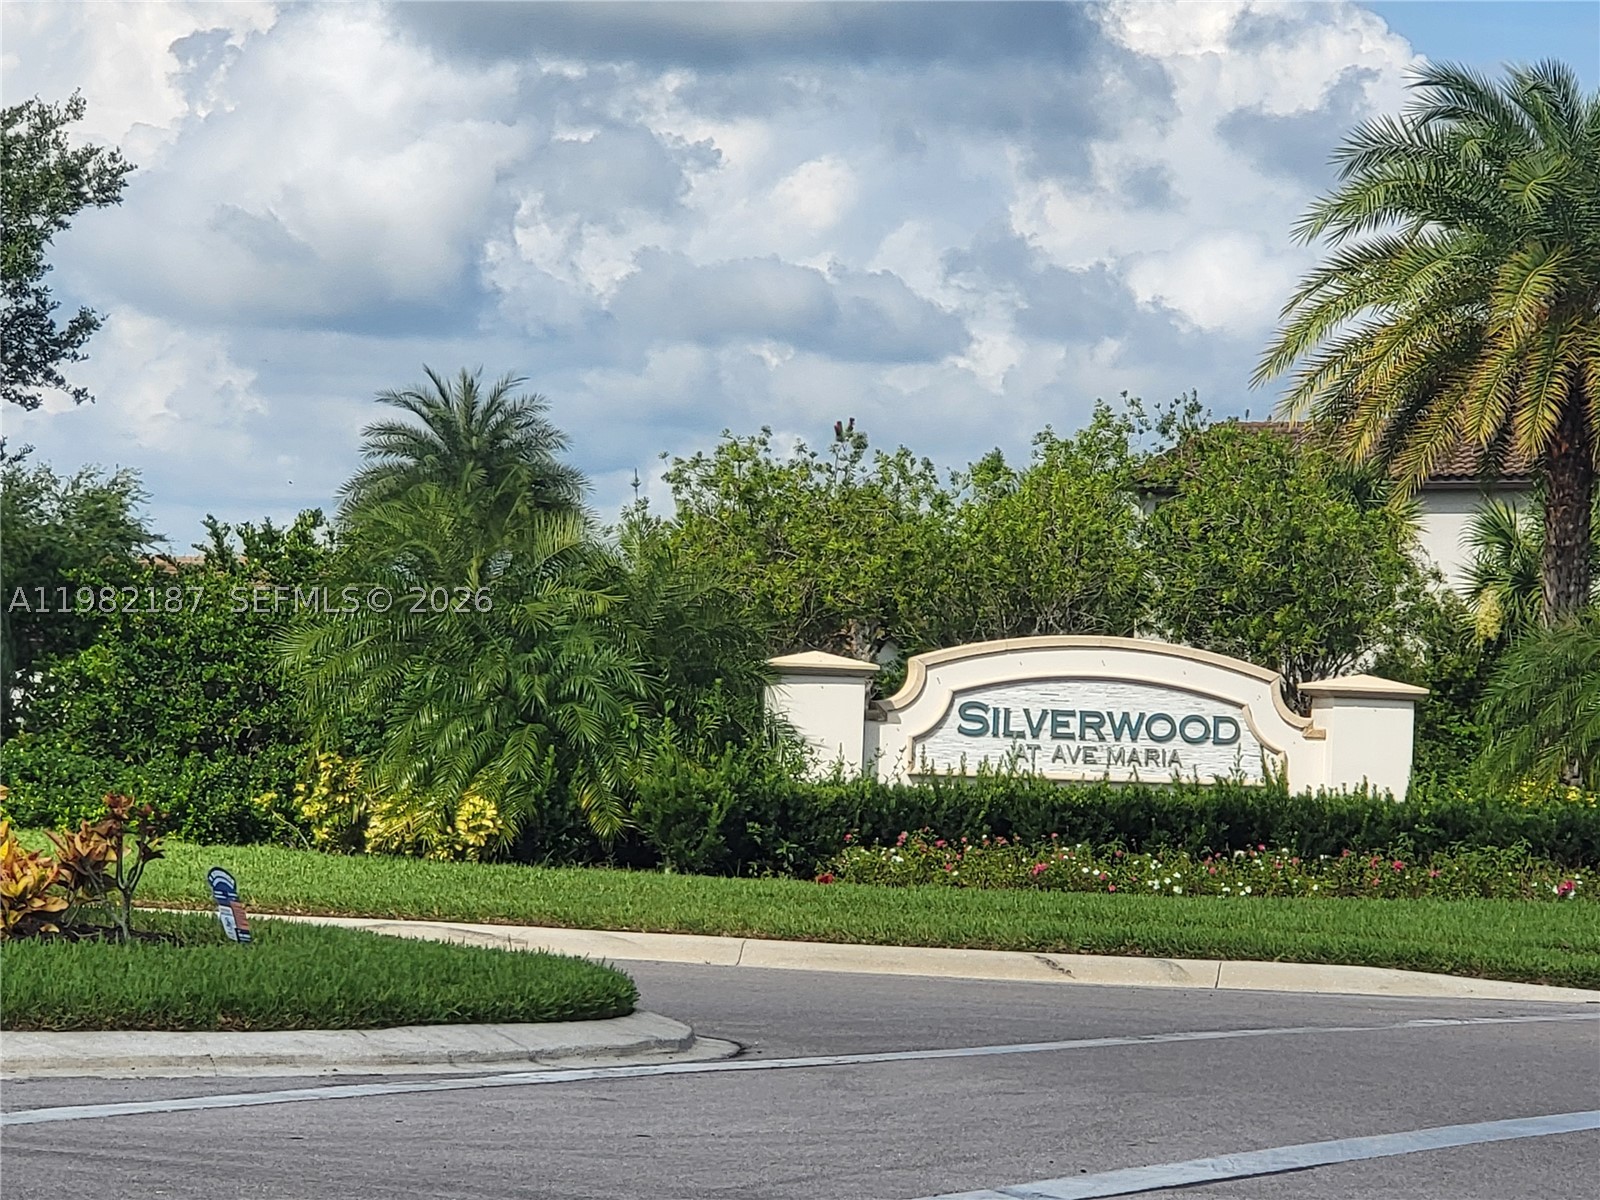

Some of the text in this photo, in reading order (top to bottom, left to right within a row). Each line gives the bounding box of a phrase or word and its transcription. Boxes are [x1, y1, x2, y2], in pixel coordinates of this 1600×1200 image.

[957, 701, 1240, 745] SILVERWOOD
[1015, 744, 1183, 768] AT AVE MARIA
